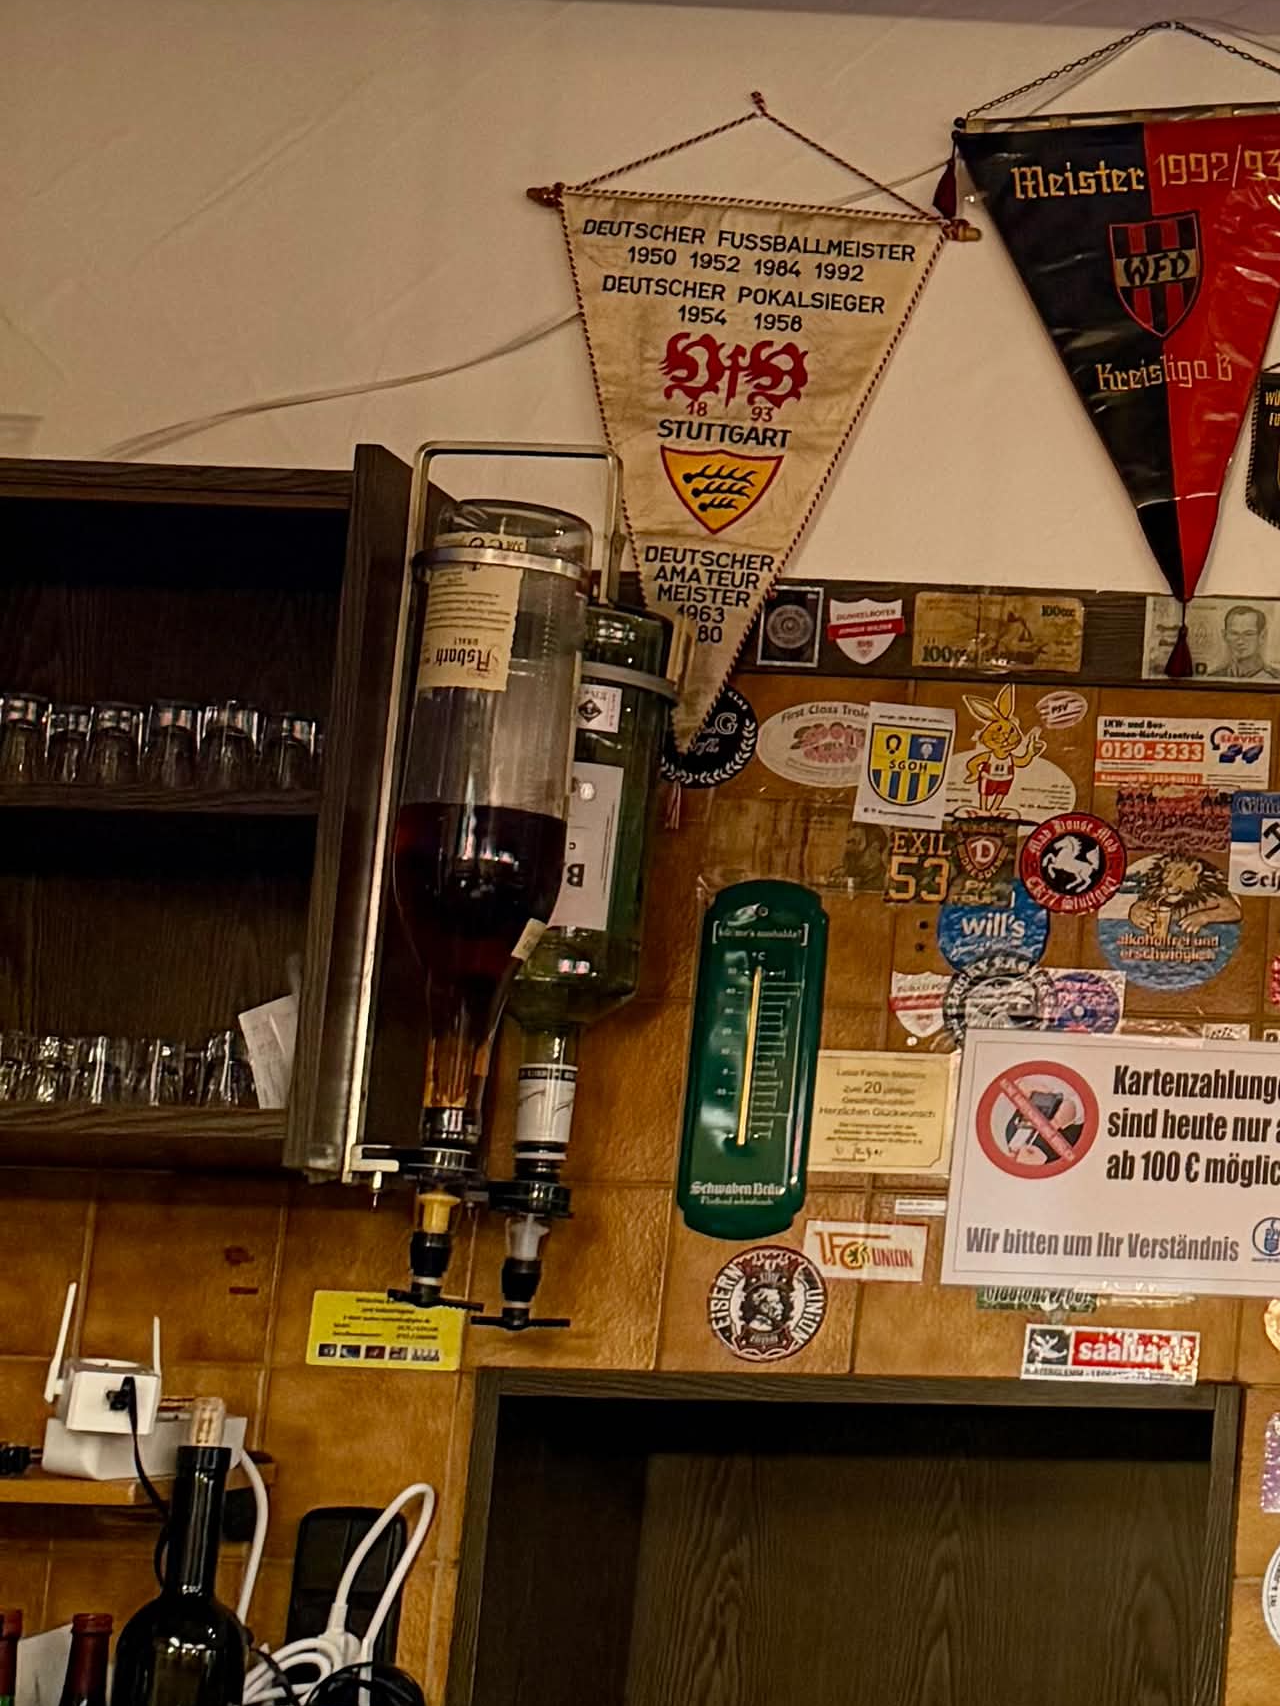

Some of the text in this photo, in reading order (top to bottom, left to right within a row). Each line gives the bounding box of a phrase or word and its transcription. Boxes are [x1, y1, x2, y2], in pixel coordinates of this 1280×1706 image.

[1011, 164, 1146, 200] Meister
[581, 217, 917, 263] DEUTSCHER FUSSBALLMEISTER
[626, 246, 865, 283] 1950 1952 1984 1992
[601, 274, 886, 315] DEUTSCHER POKALSIEGER
[677, 304, 803, 333] 1954 1958
[1095, 359, 1210, 393] Kreisliga
[685, 399, 774, 423] 18 93
[656, 417, 792, 449] STUTTGART
[643, 543, 775, 575] DEUTSCHER
[653, 562, 761, 590] AMATEUR
[655, 583, 751, 608] MEISTER
[888, 758, 929, 773] SGOH
[1101, 741, 1204, 762] 0130-5333
[892, 830, 953, 857] EXIL
[889, 855, 952, 904] 53
[960, 911, 1028, 939] will's
[863, 1080, 883, 1095] 20
[1106, 1108, 1158, 1139] sind
[1162, 1111, 1228, 1142] heute
[1231, 1118, 1272, 1143] nur
[1106, 1151, 1136, 1181] ab
[1141, 1150, 1179, 1181] 100
[1184, 1151, 1201, 1182] €
[689, 1180, 751, 1195] Schwaben
[871, 1246, 914, 1270] UNION
[966, 1226, 1240, 1263] Wir bitten um Ihr Verständnis
[711, 1260, 746, 1332] EISERN
